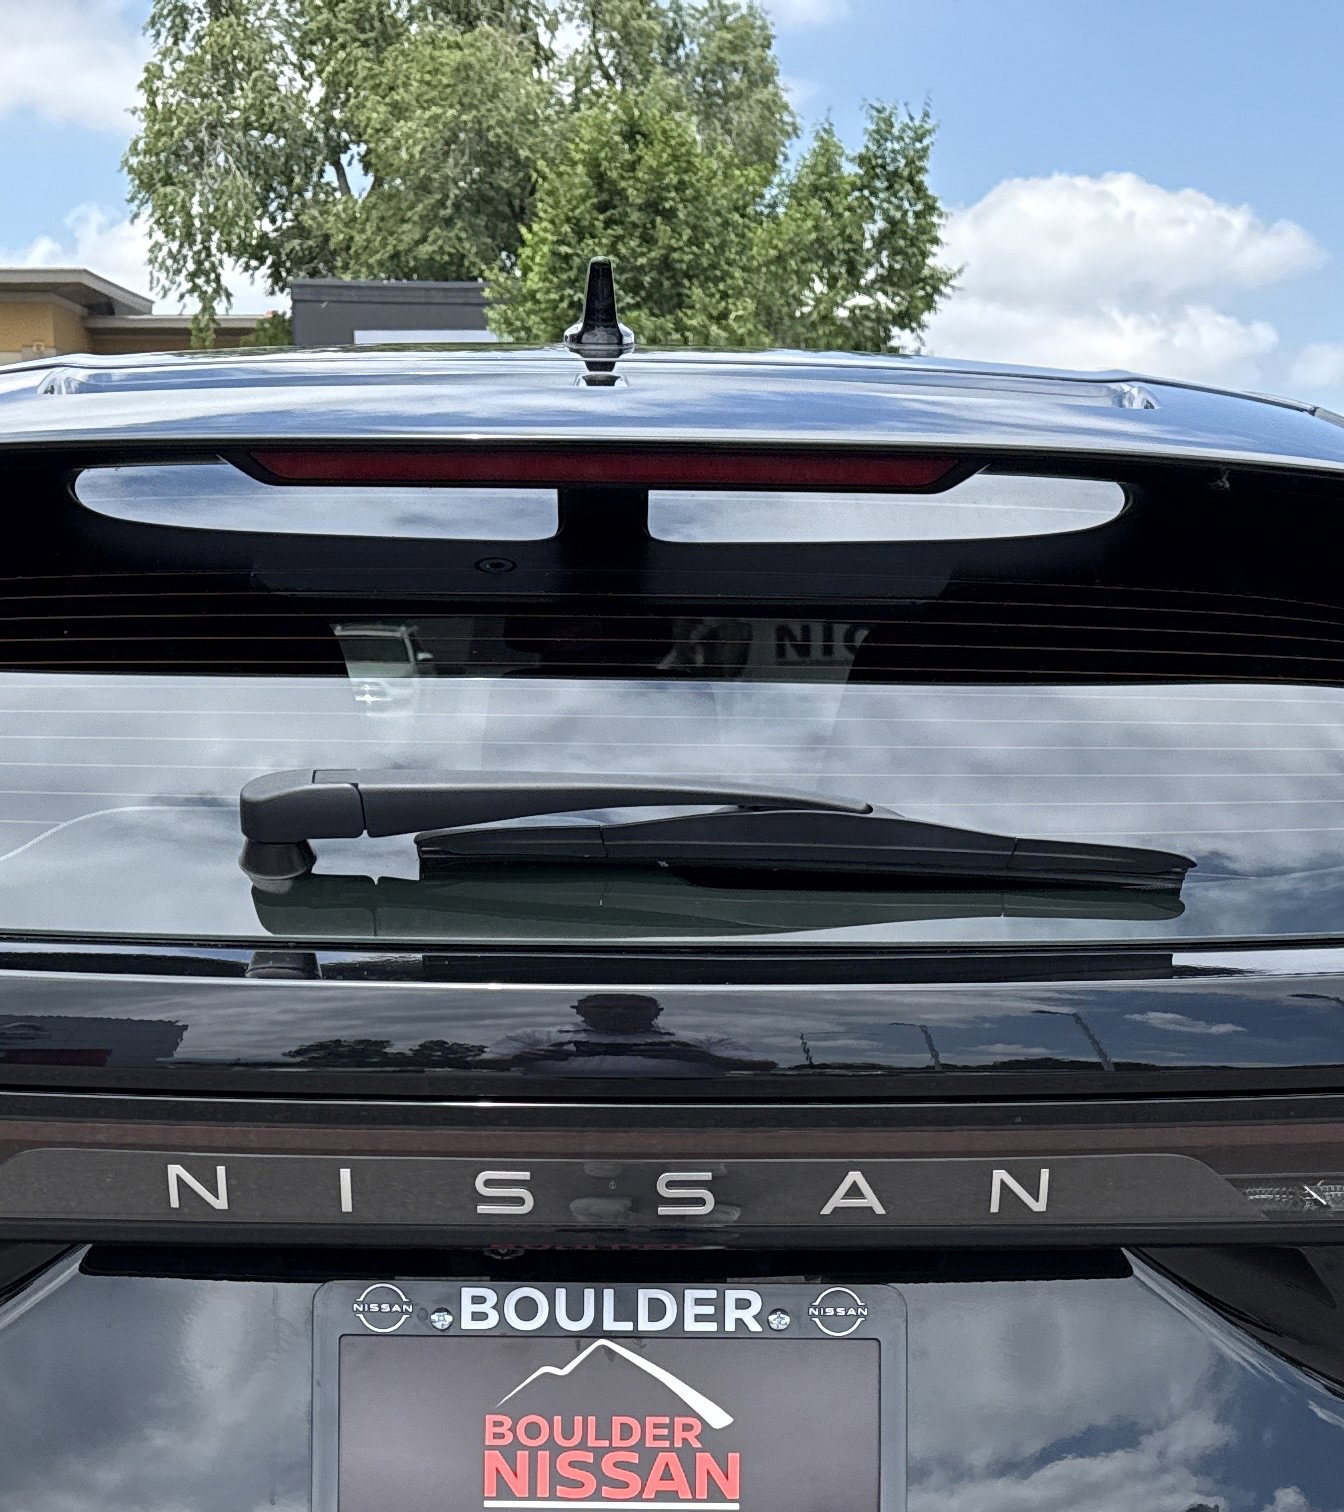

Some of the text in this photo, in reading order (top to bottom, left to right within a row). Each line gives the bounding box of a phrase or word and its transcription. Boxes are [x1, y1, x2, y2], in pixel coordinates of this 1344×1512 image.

[166, 1163, 1051, 1216] NISSAN
[353, 1303, 413, 1313] NISSAN
[460, 1287, 763, 1332] BOULDER
[808, 1307, 868, 1316] NISSAN
[484, 1414, 702, 1449] BOULDER
[484, 1449, 740, 1500] NISSAN
